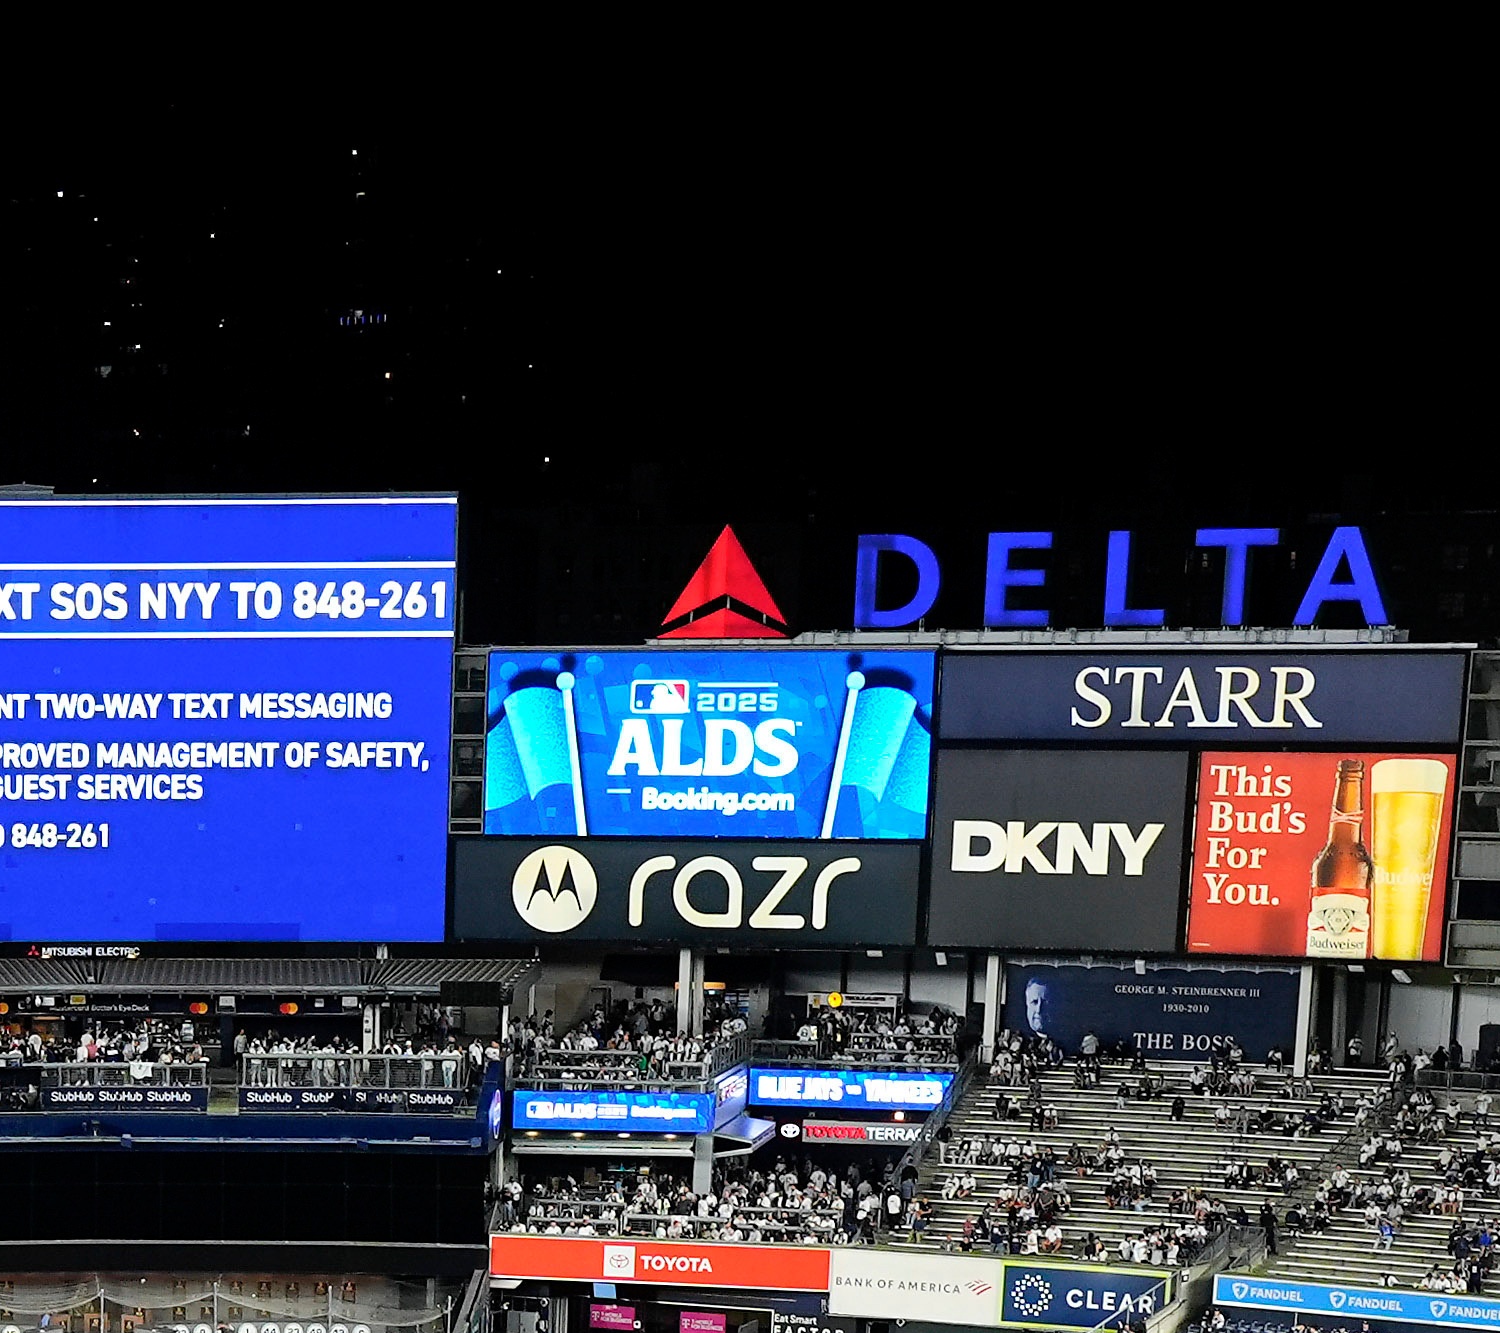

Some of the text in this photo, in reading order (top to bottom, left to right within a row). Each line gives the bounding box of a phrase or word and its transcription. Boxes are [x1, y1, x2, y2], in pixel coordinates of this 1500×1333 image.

[854, 526, 1390, 628] DELTA
[50, 582, 127, 620] SOS
[140, 582, 221, 620] NYY
[230, 582, 283, 620] TO
[293, 581, 447, 620] 848-261
[36, 693, 162, 719] TWO-WAY
[169, 693, 232, 719] TEXT
[239, 693, 392, 719] MESSAGING
[697, 693, 778, 712] 2025
[1070, 666, 1322, 729] STARR
[96, 743, 279, 768] MANAGEMENT
[285, 743, 319, 767] OF
[326, 743, 428, 773] SAFETY,
[607, 718, 800, 776] ALDS
[77, 775, 203, 800] SERVICES
[1210, 764, 1292, 798] This
[641, 787, 794, 815] Booking.com
[1209, 801, 1306, 835] Bud's
[11, 824, 109, 848] 848-261
[951, 819, 1165, 876] DKNY
[1205, 837, 1263, 870] For
[628, 855, 861, 930] razr
[1203, 874, 1280, 908] You.
[1115, 984, 1154, 995] GEORGE
[1133, 1032, 1173, 1050] THE
[51, 1091, 191, 1102] StubHub StubHub
[247, 1092, 453, 1105] StubHub StubHub
[805, 1124, 866, 1141] TOYOTA
[640, 1255, 713, 1273] TOYOTA
[835, 1275, 961, 1296] BANK OF AMERICA
[1250, 1286, 1304, 1302] FANDUEL
[1348, 1295, 1402, 1312] FANDUEL
[790, 1315, 817, 1325] Smart
